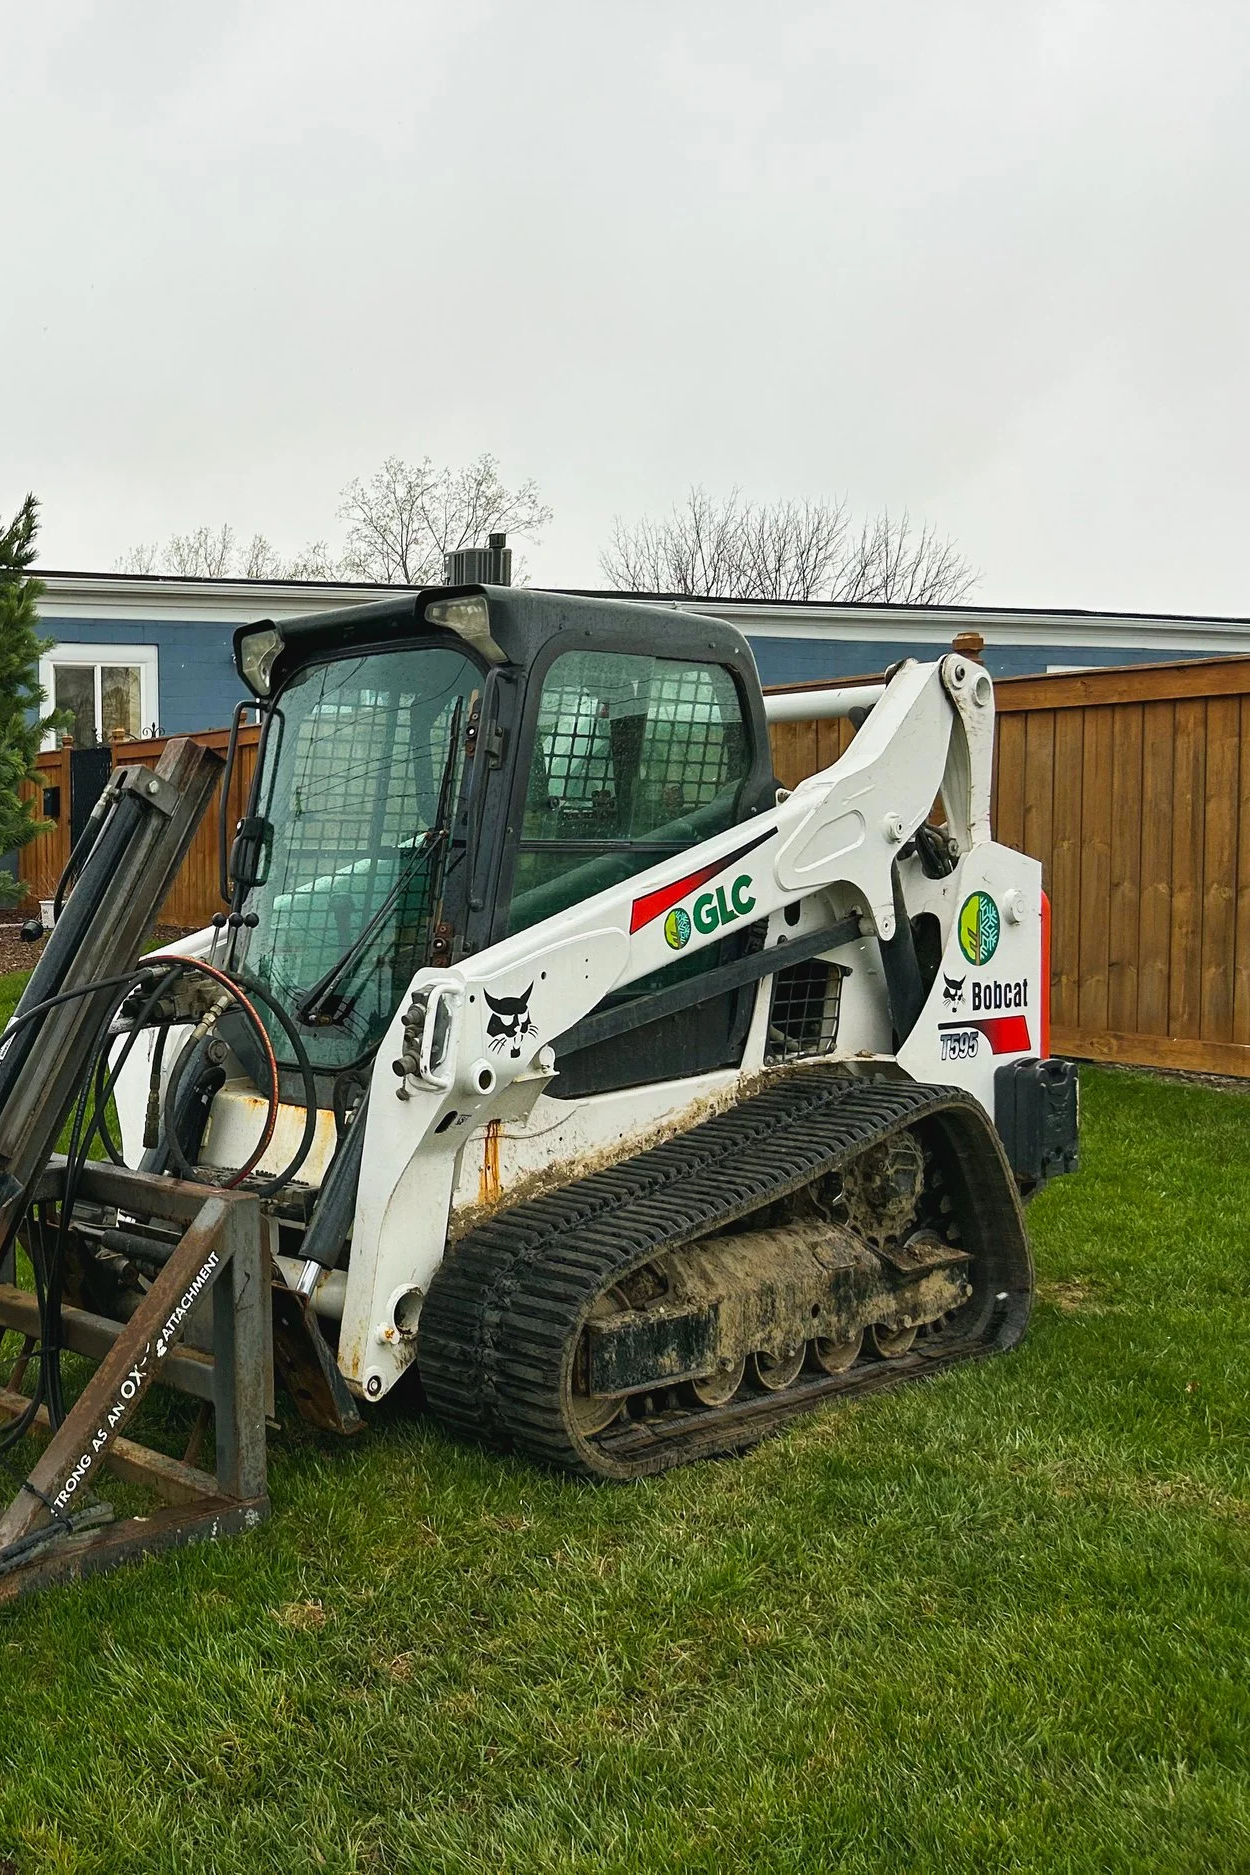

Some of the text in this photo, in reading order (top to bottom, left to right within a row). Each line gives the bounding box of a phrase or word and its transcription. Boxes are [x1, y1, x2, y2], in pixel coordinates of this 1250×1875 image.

[693, 874, 757, 934] GLC
[971, 978, 1028, 1011] Bobcat
[940, 1031, 979, 1061] T595
[92, 1428, 108, 1453] AS
[107, 1401, 126, 1428] AN
[162, 1251, 220, 1342] ATTACHMENT
